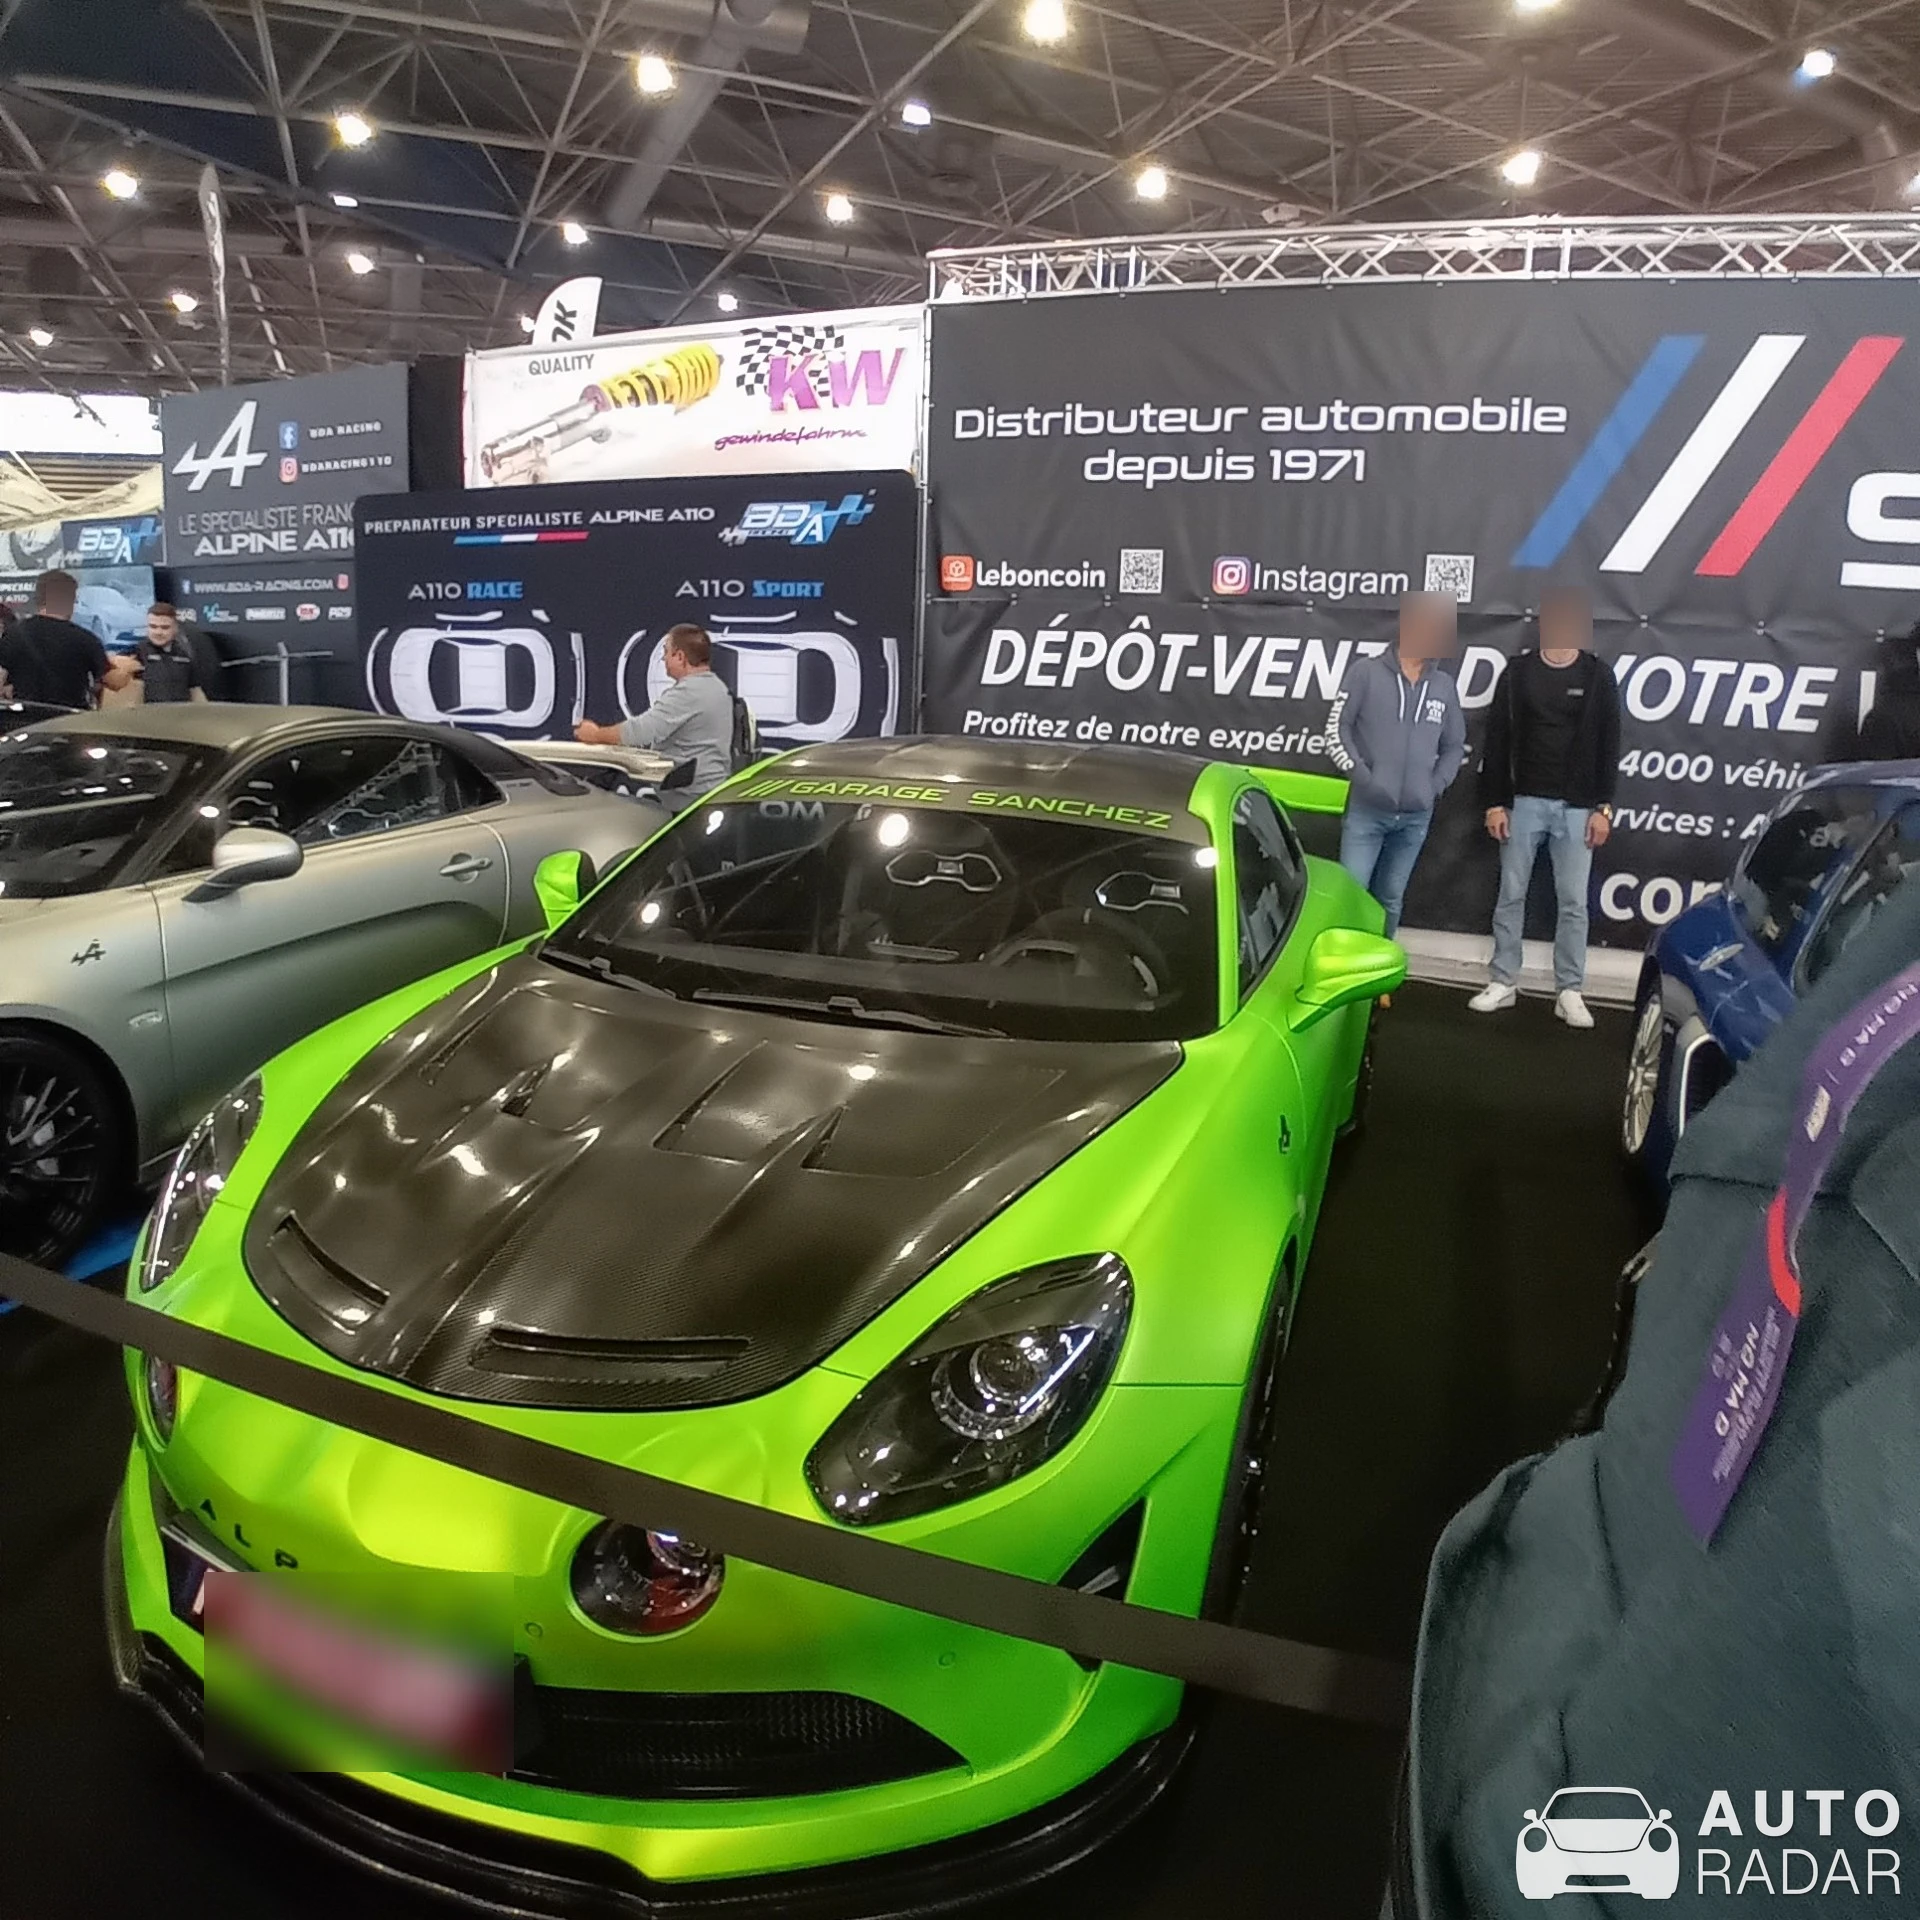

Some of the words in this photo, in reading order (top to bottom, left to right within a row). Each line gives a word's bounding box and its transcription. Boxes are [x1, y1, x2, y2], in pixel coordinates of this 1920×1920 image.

[529, 354, 594, 375] QUALITY
[769, 348, 906, 411] KW
[337, 421, 382, 434] RACING
[954, 402, 1248, 439] Distributeur
[1260, 398, 1567, 433] automobile
[1083, 448, 1255, 489] depuis
[1269, 448, 1366, 481] 1971
[179, 514, 197, 535] LE
[202, 506, 297, 532] SPECIALISTE
[364, 517, 471, 534] PREPARATEUR
[476, 511, 582, 529] SPECIALISTE
[589, 508, 664, 524] ALPINE
[668, 507, 715, 522] A110
[194, 530, 298, 556] ALPINE
[675, 580, 745, 597] A110
[976, 561, 1105, 587] leboncoin
[1254, 563, 1408, 600] Instagram
[407, 582, 461, 599] A110
[467, 581, 523, 598] RACE
[963, 710, 1067, 738] Profitez
[1076, 715, 1112, 740] de
[1120, 720, 1199, 747] notre
[1209, 724, 1328, 757] expérie
[1619, 749, 1713, 782] 4000
[789, 780, 950, 801] GARAGE
[967, 790, 1172, 828] SANCHEZ
[1613, 804, 1714, 837] rvices
